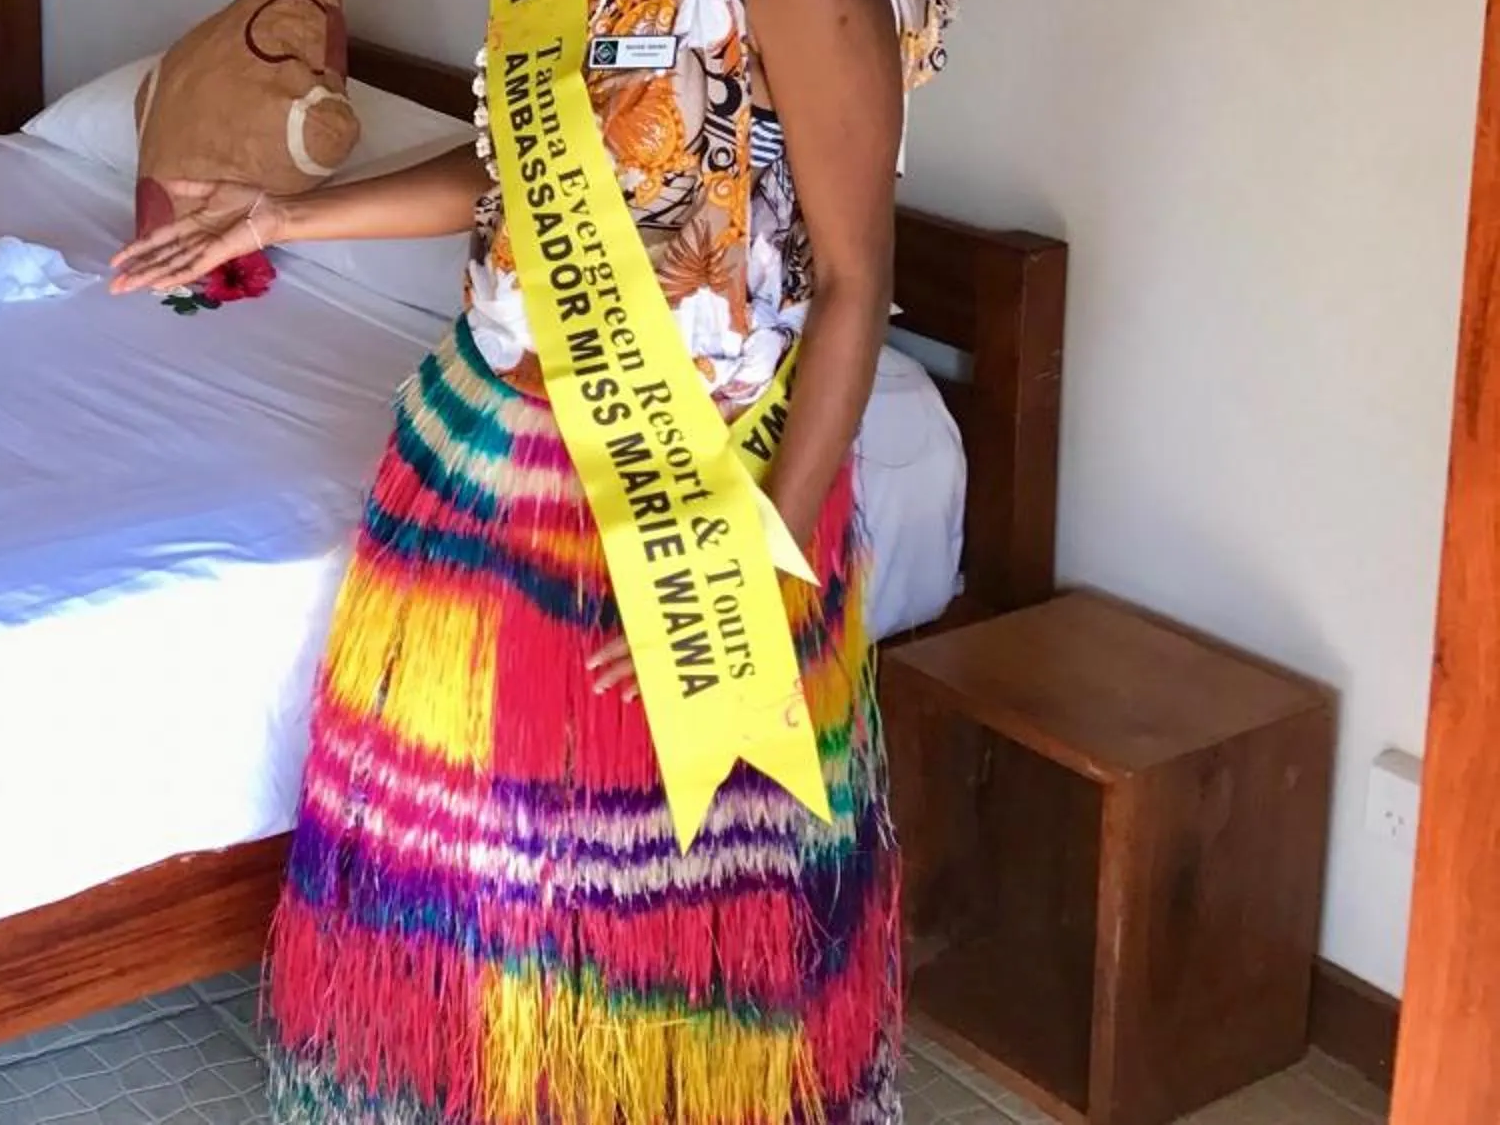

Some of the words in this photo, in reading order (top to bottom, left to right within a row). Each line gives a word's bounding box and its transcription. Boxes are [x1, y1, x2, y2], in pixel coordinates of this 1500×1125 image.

[533, 37, 566, 157] Tanna
[558, 166, 646, 373] Evergreen
[505, 53, 590, 321] AMBASSADOR
[566, 329, 631, 427] MISS
[607, 432, 685, 562] MARIE
[654, 568, 720, 699] WAWA
[634, 379, 713, 504] Resort
[691, 516, 730, 549] &
[706, 559, 756, 680] Tours
